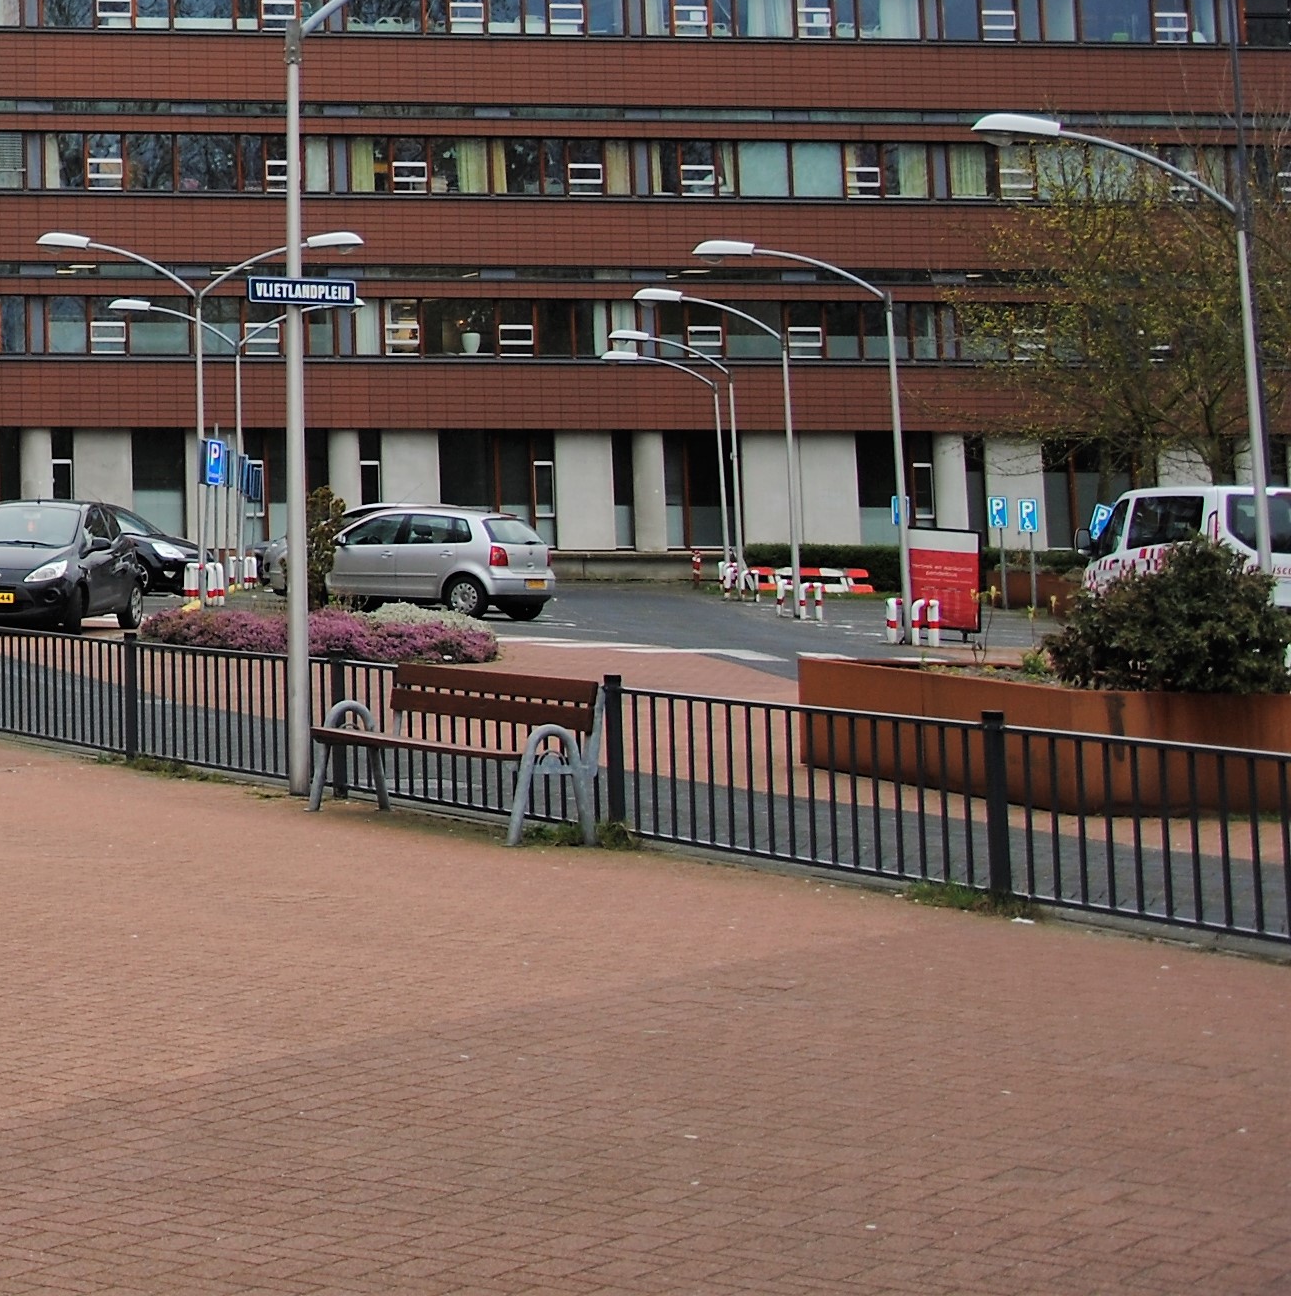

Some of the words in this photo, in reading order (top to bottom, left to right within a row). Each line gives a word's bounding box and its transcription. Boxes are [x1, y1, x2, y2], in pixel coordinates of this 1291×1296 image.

[255, 282, 350, 301] VLIETLANDPLEIN
[210, 444, 219, 465] P
[991, 499, 1003, 515] P
[1022, 501, 1034, 519] P
[1095, 508, 1108, 525] P
